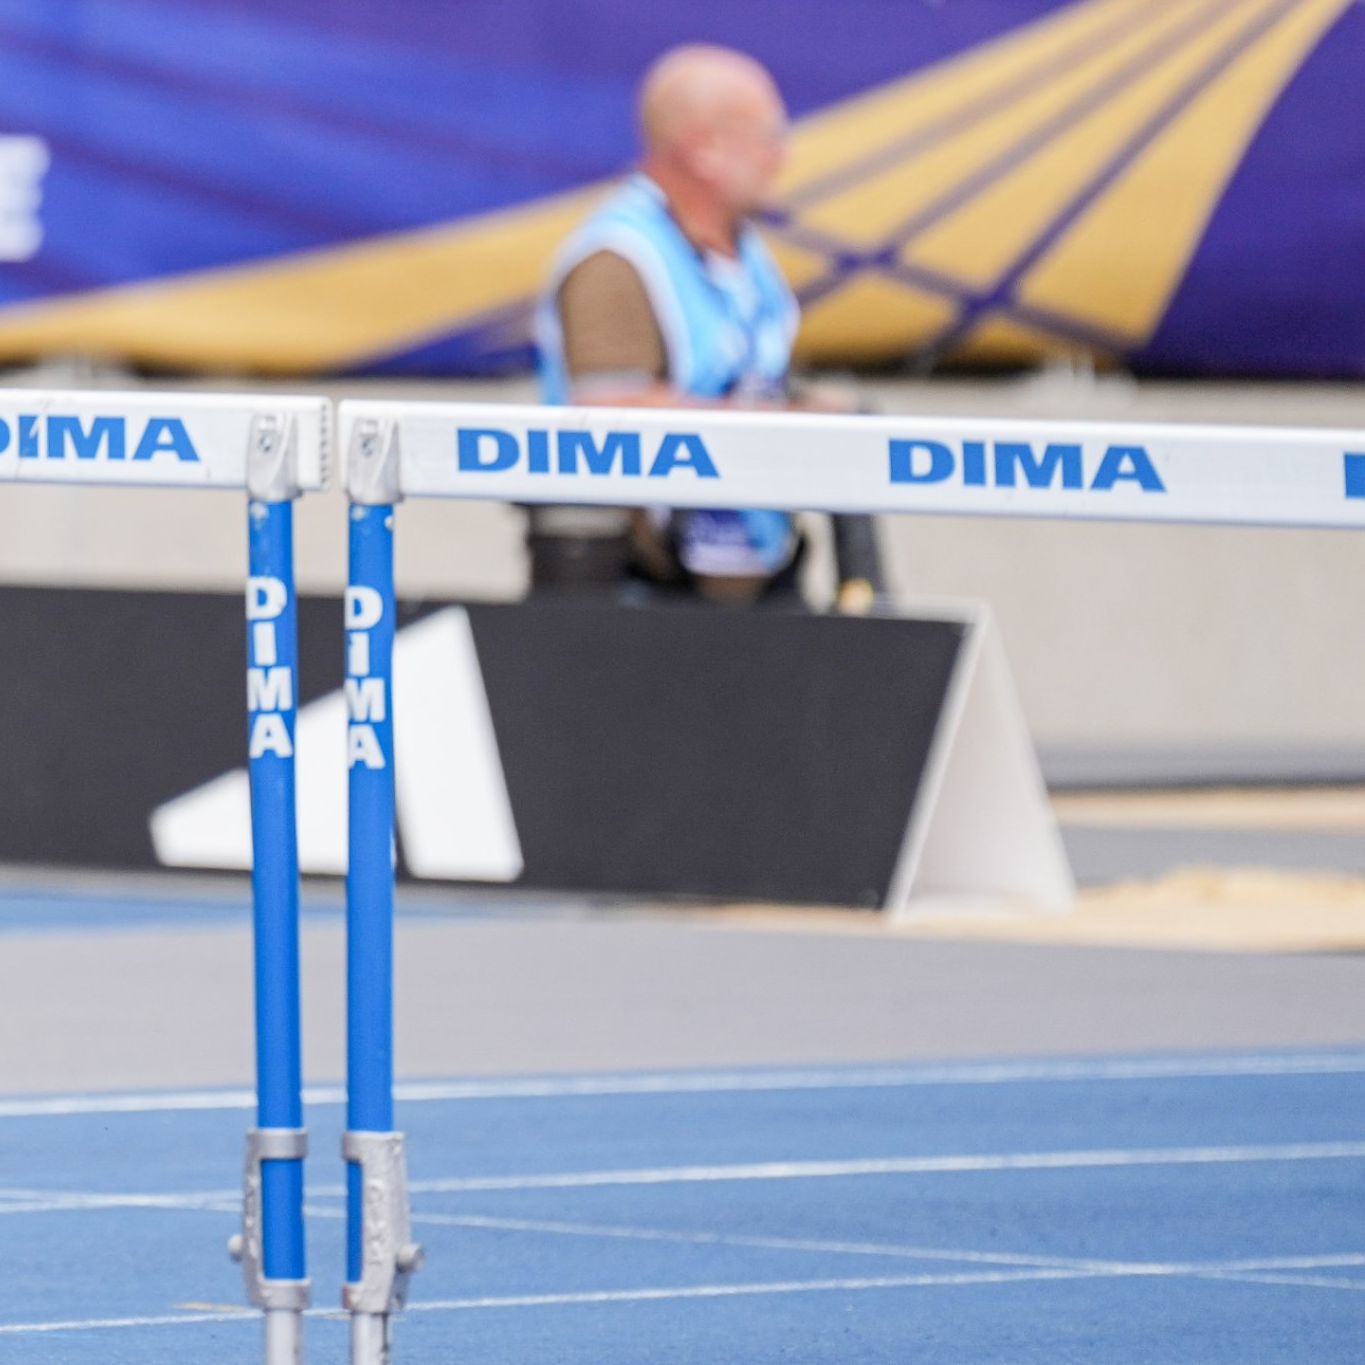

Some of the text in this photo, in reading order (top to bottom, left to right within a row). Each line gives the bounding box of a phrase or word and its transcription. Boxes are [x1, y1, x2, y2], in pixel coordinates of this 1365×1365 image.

[456, 427, 1167, 493] DIMA DIMA
[245, 576, 294, 758] DIMA
[344, 585, 386, 769] DIMA
